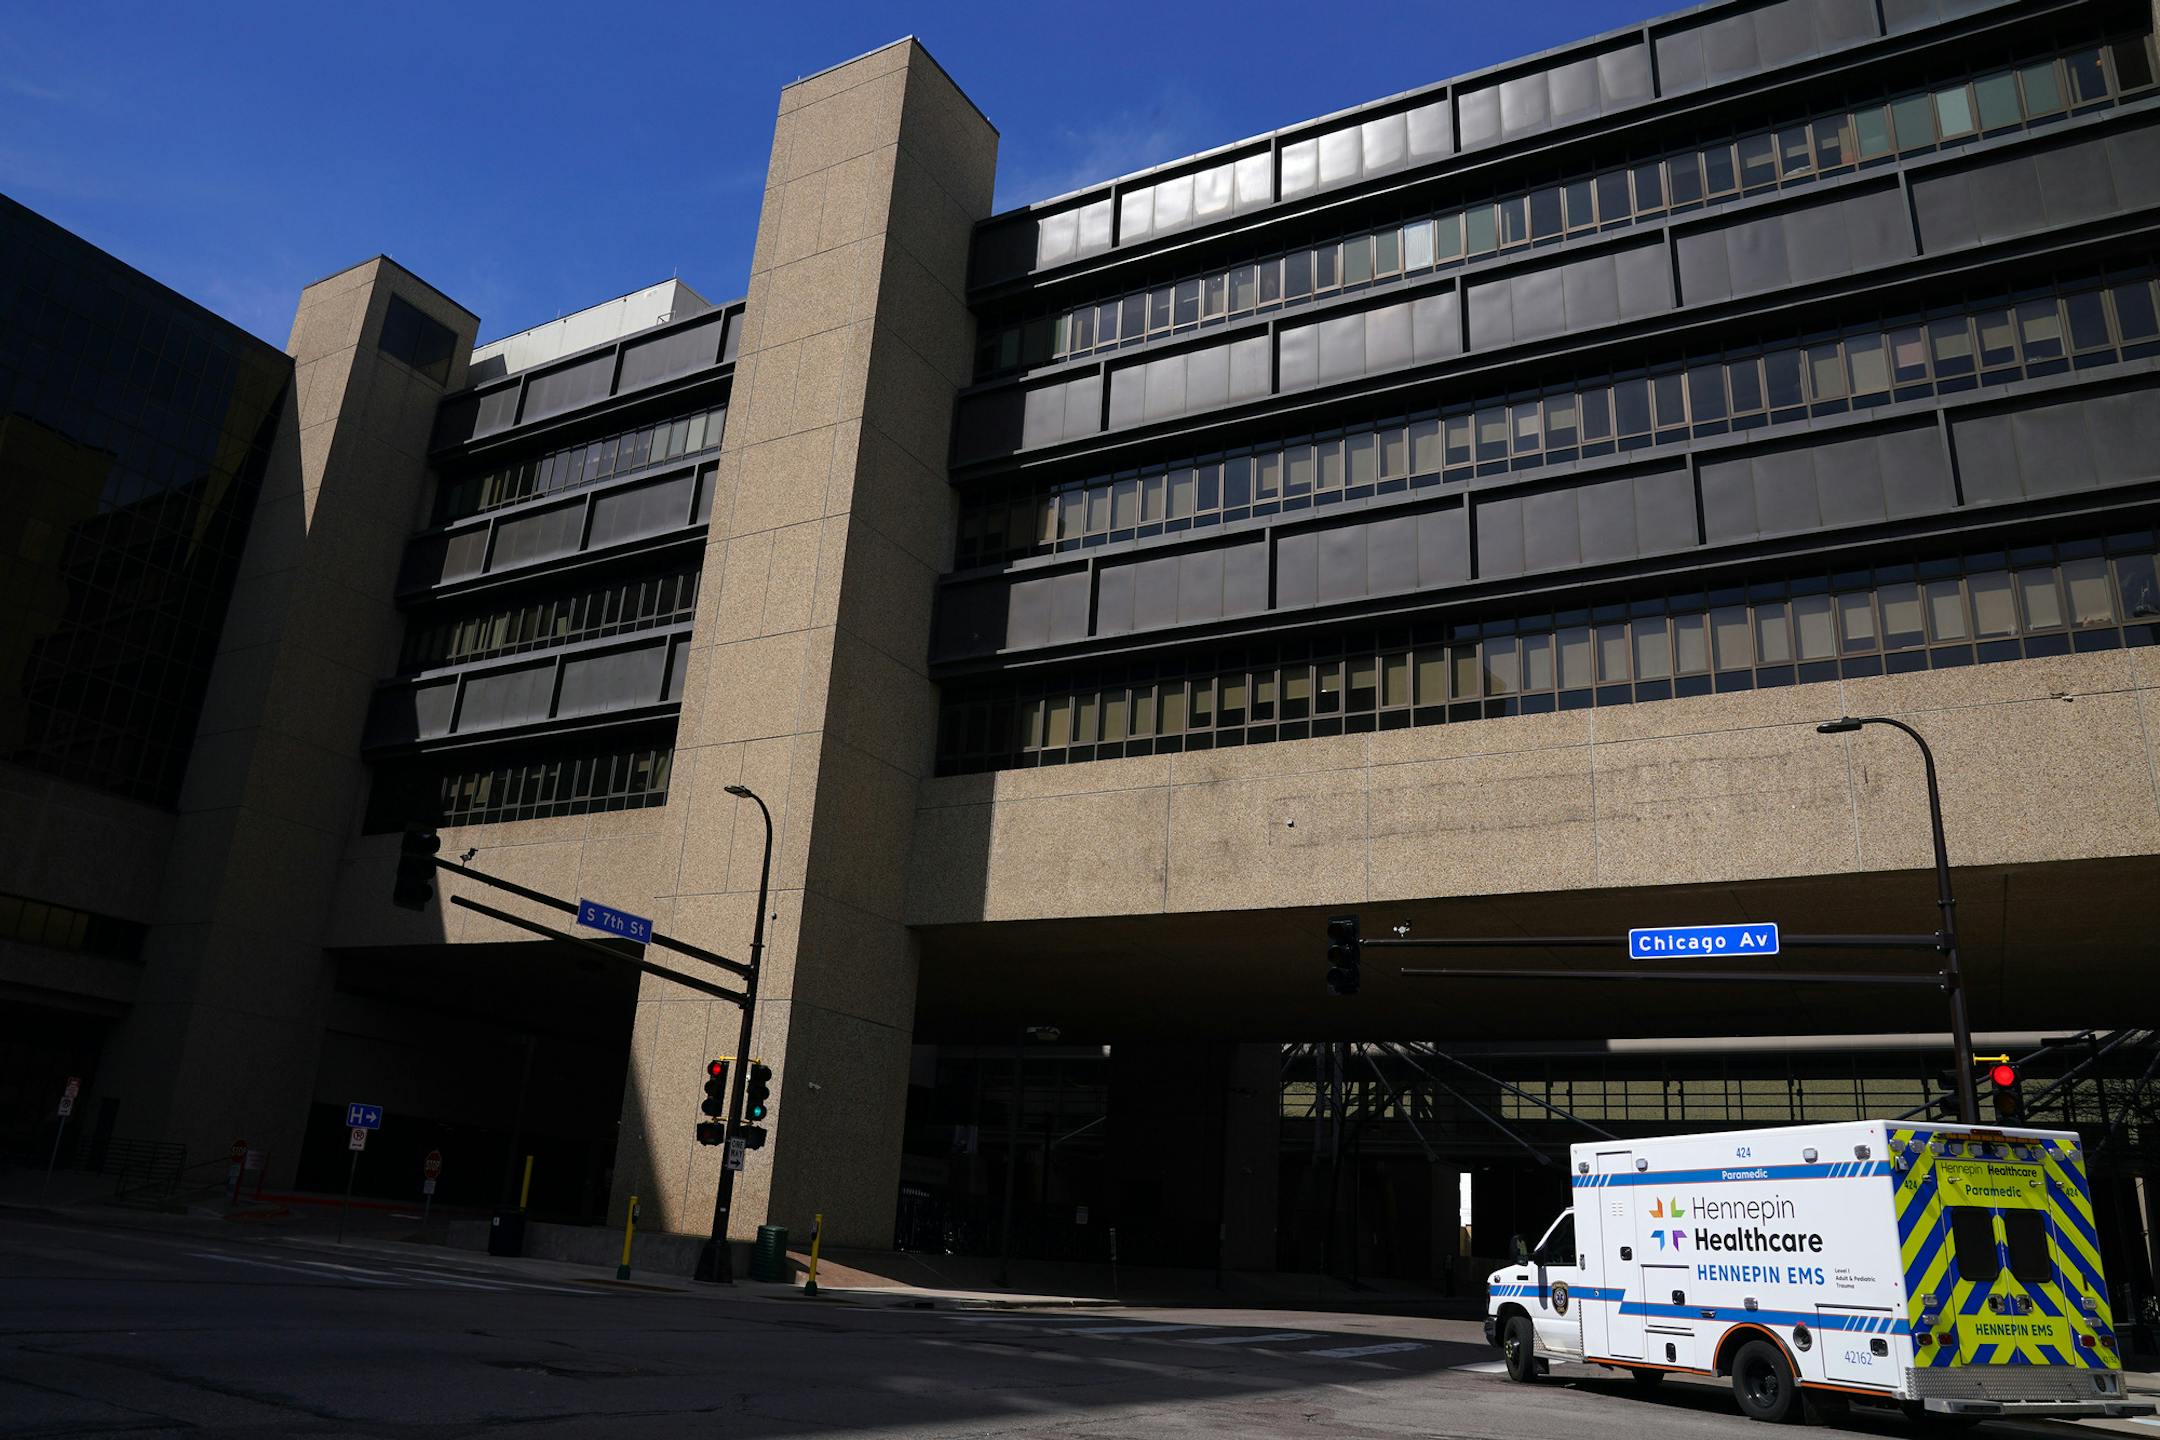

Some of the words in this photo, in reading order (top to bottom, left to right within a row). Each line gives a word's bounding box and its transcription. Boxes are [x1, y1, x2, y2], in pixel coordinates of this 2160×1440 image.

[586, 907, 596, 922] S
[602, 912, 624, 931] 7th
[630, 921, 645, 937] St
[1638, 934, 1727, 954] Chicago
[1739, 931, 1768, 948] Av
[350, 1106, 364, 1125] H
[731, 1139, 744, 1148] ONE
[1736, 1147, 1751, 1158] 424
[1721, 1168, 1768, 1180] Paramedic
[1941, 1162, 1983, 1175] Hennepin
[1987, 1164, 2037, 1178] Healthcare
[1904, 1180, 1918, 1190] 424
[1965, 1184, 2022, 1198] Paramedic
[2065, 1187, 2079, 1197] 424
[1692, 1194, 1795, 1227] Hennepin
[1694, 1227, 1823, 1253] Healthcare
[1697, 1264, 1781, 1284] HENNEPIN
[1787, 1266, 1825, 1286] EMS
[1975, 1323, 2029, 1336] HENNEPIN
[2031, 1324, 2054, 1337] EMS
[1844, 1350, 1872, 1365] 42162
